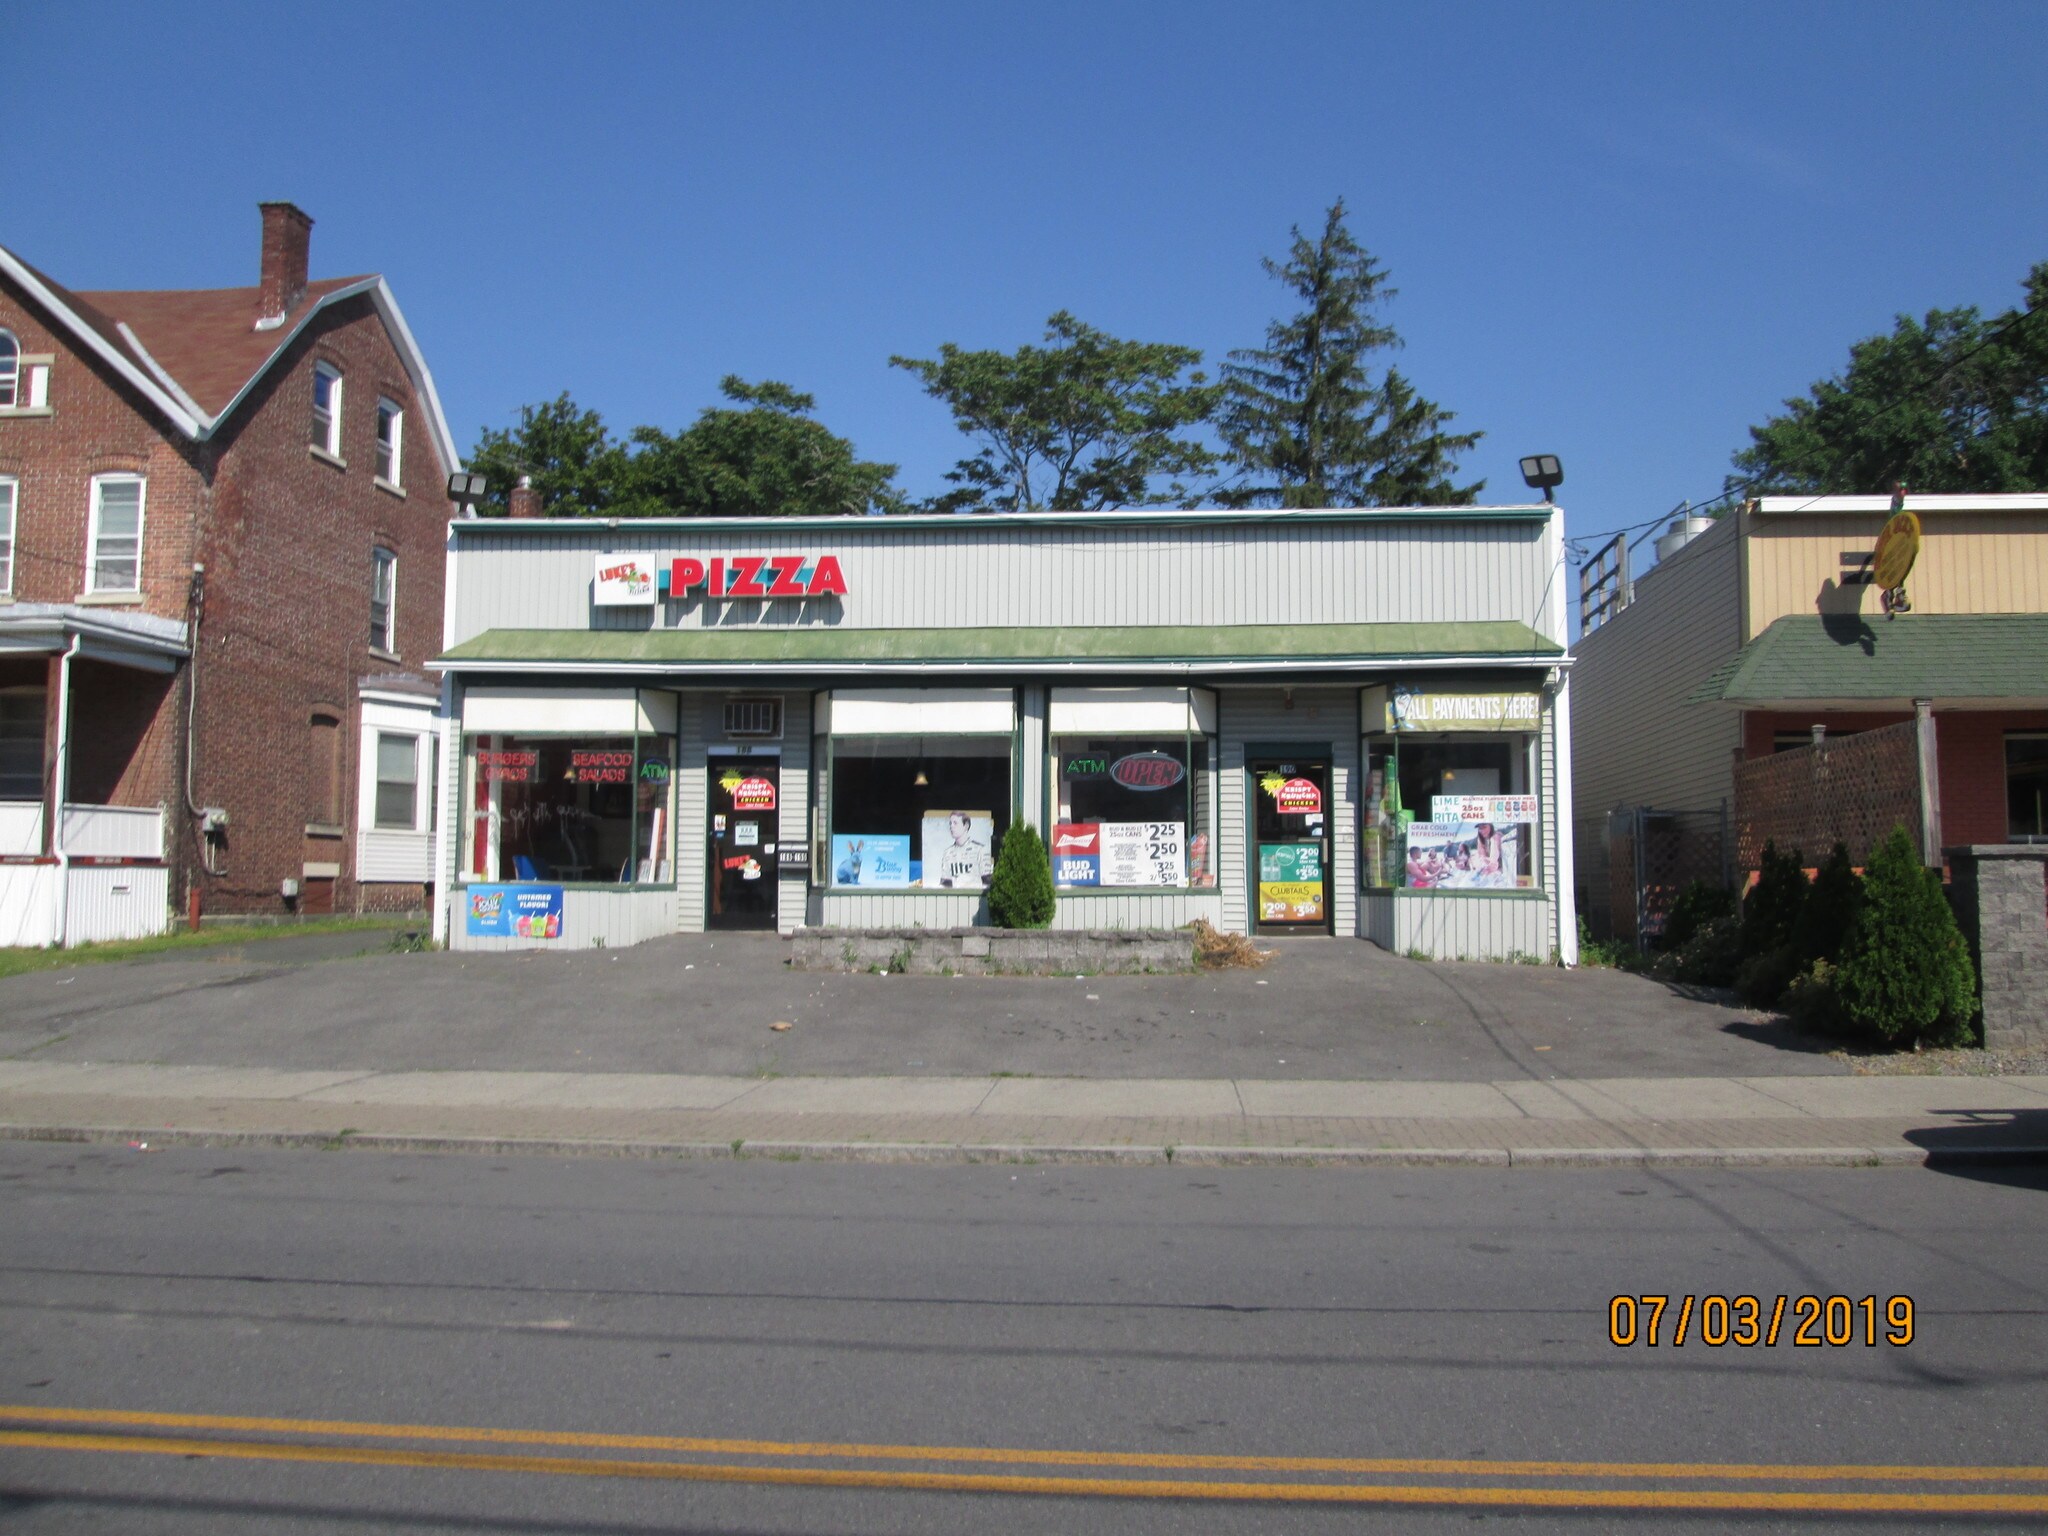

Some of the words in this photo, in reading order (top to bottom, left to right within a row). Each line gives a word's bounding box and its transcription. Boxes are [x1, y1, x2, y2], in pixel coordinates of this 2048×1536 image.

[598, 562, 636, 583] LUKE'S
[670, 556, 849, 598] PIZZA
[1408, 696, 1429, 720] ALL
[1432, 696, 1501, 720] PAYMENTS
[1504, 696, 1540, 719] HERE!
[478, 753, 536, 767] BURGERS
[573, 753, 633, 767] SEAFOOD
[1066, 759, 1105, 773] ATM
[485, 767, 528, 782] GYROS
[579, 768, 626, 782] SALADS
[640, 764, 669, 778] ATM
[1119, 759, 1179, 787] OPEN
[1433, 797, 1460, 806] LIME
[1434, 813, 1460, 822] RITA
[1063, 860, 1091, 870] BUD
[1057, 869, 1096, 880] LIGHT
